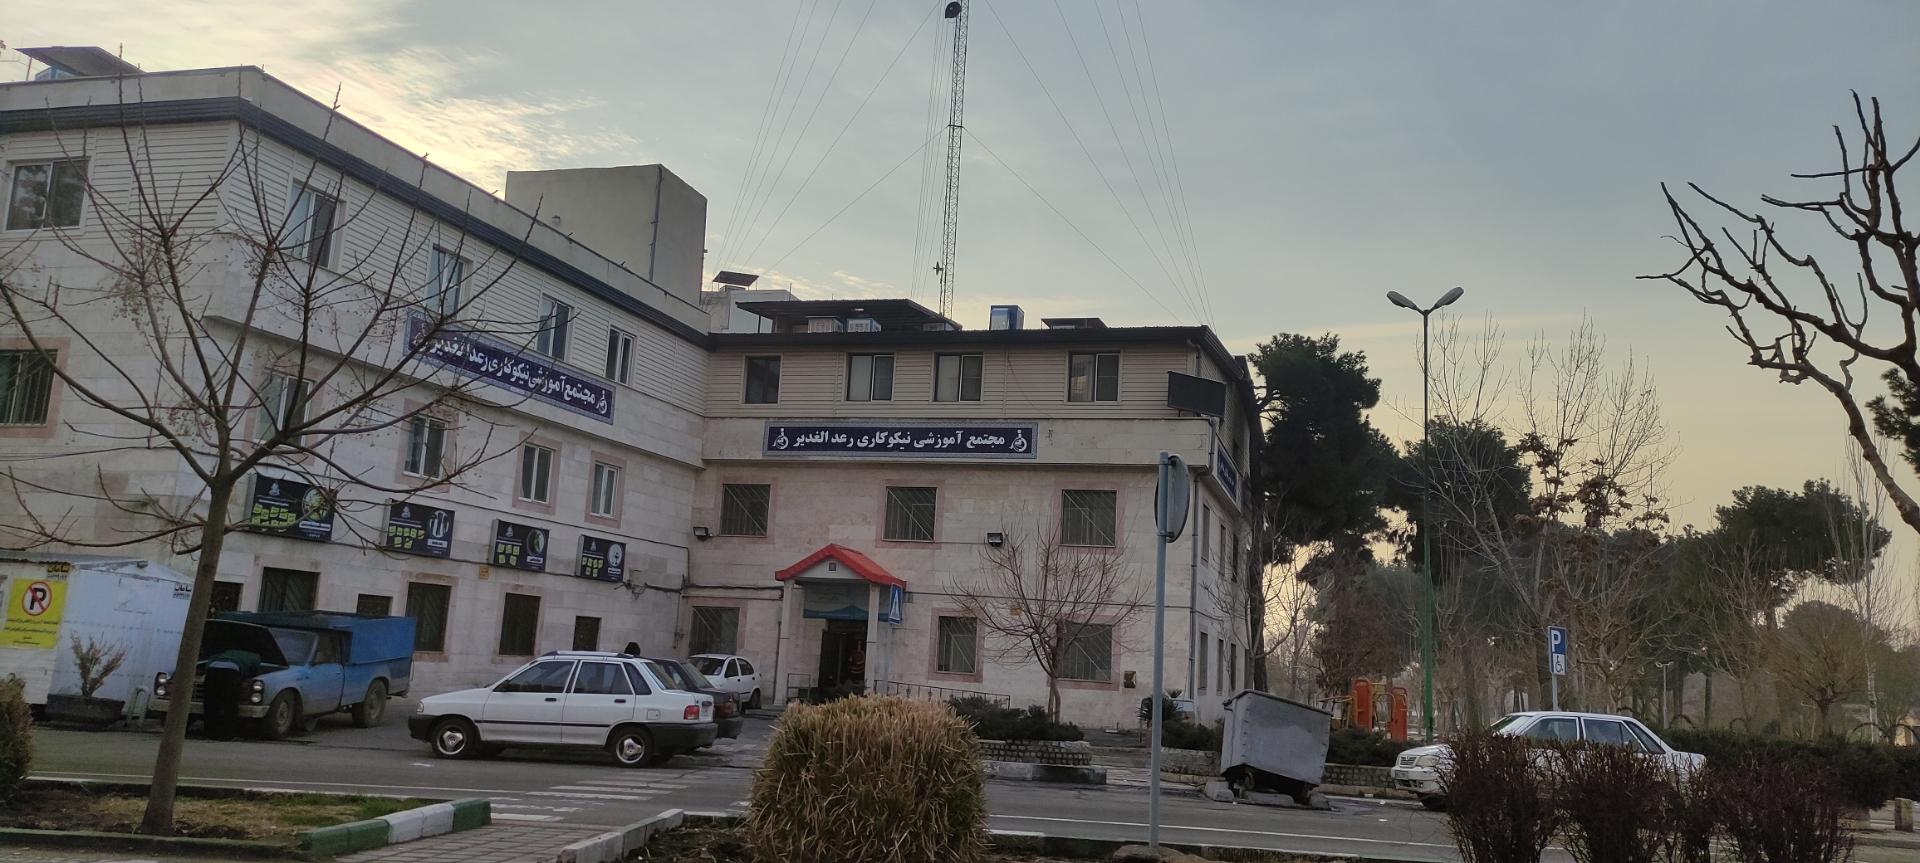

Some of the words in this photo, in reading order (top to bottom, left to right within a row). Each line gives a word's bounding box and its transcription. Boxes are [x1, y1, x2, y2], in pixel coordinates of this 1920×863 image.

[469, 350, 488, 371] رعد
[488, 358, 529, 384] نیکوکاری
[529, 369, 565, 393] آموزشی
[564, 385, 595, 403] مجتمع
[792, 430, 829, 447] الغدیر
[830, 433, 854, 448] رعد
[857, 431, 911, 450] نیکوکاری
[913, 430, 963, 449] آموزشی
[966, 434, 1005, 449] مجتمع
[1550, 630, 1562, 652] P
